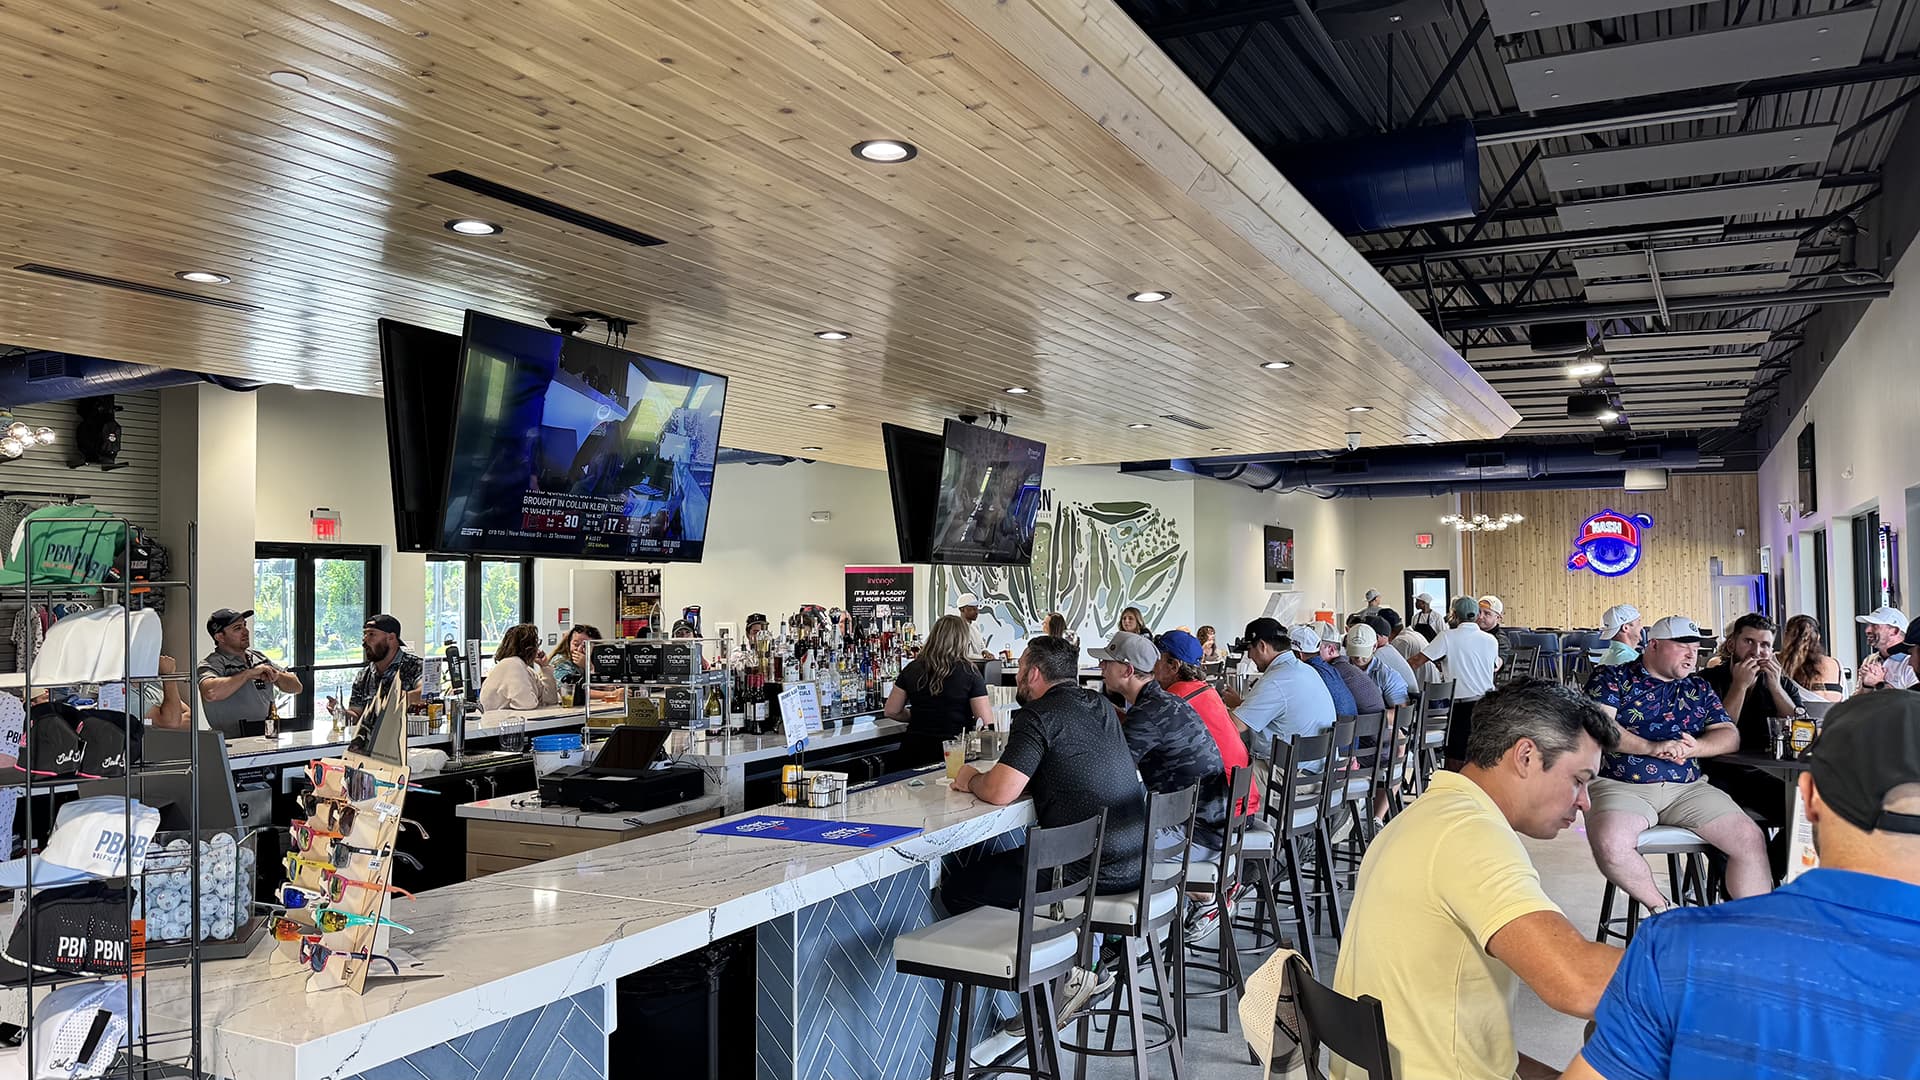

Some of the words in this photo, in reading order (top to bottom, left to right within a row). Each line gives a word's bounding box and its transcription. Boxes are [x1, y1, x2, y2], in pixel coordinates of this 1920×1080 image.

[523, 495, 556, 507] BROUGHT
[557, 499, 565, 507] IN
[565, 500, 588, 509] COLLIN
[610, 503, 625, 513] THIS
[564, 515, 579, 528] 30
[607, 518, 619, 531] 17
[461, 527, 483, 536] ESPN
[94, 939, 124, 961] PBN
